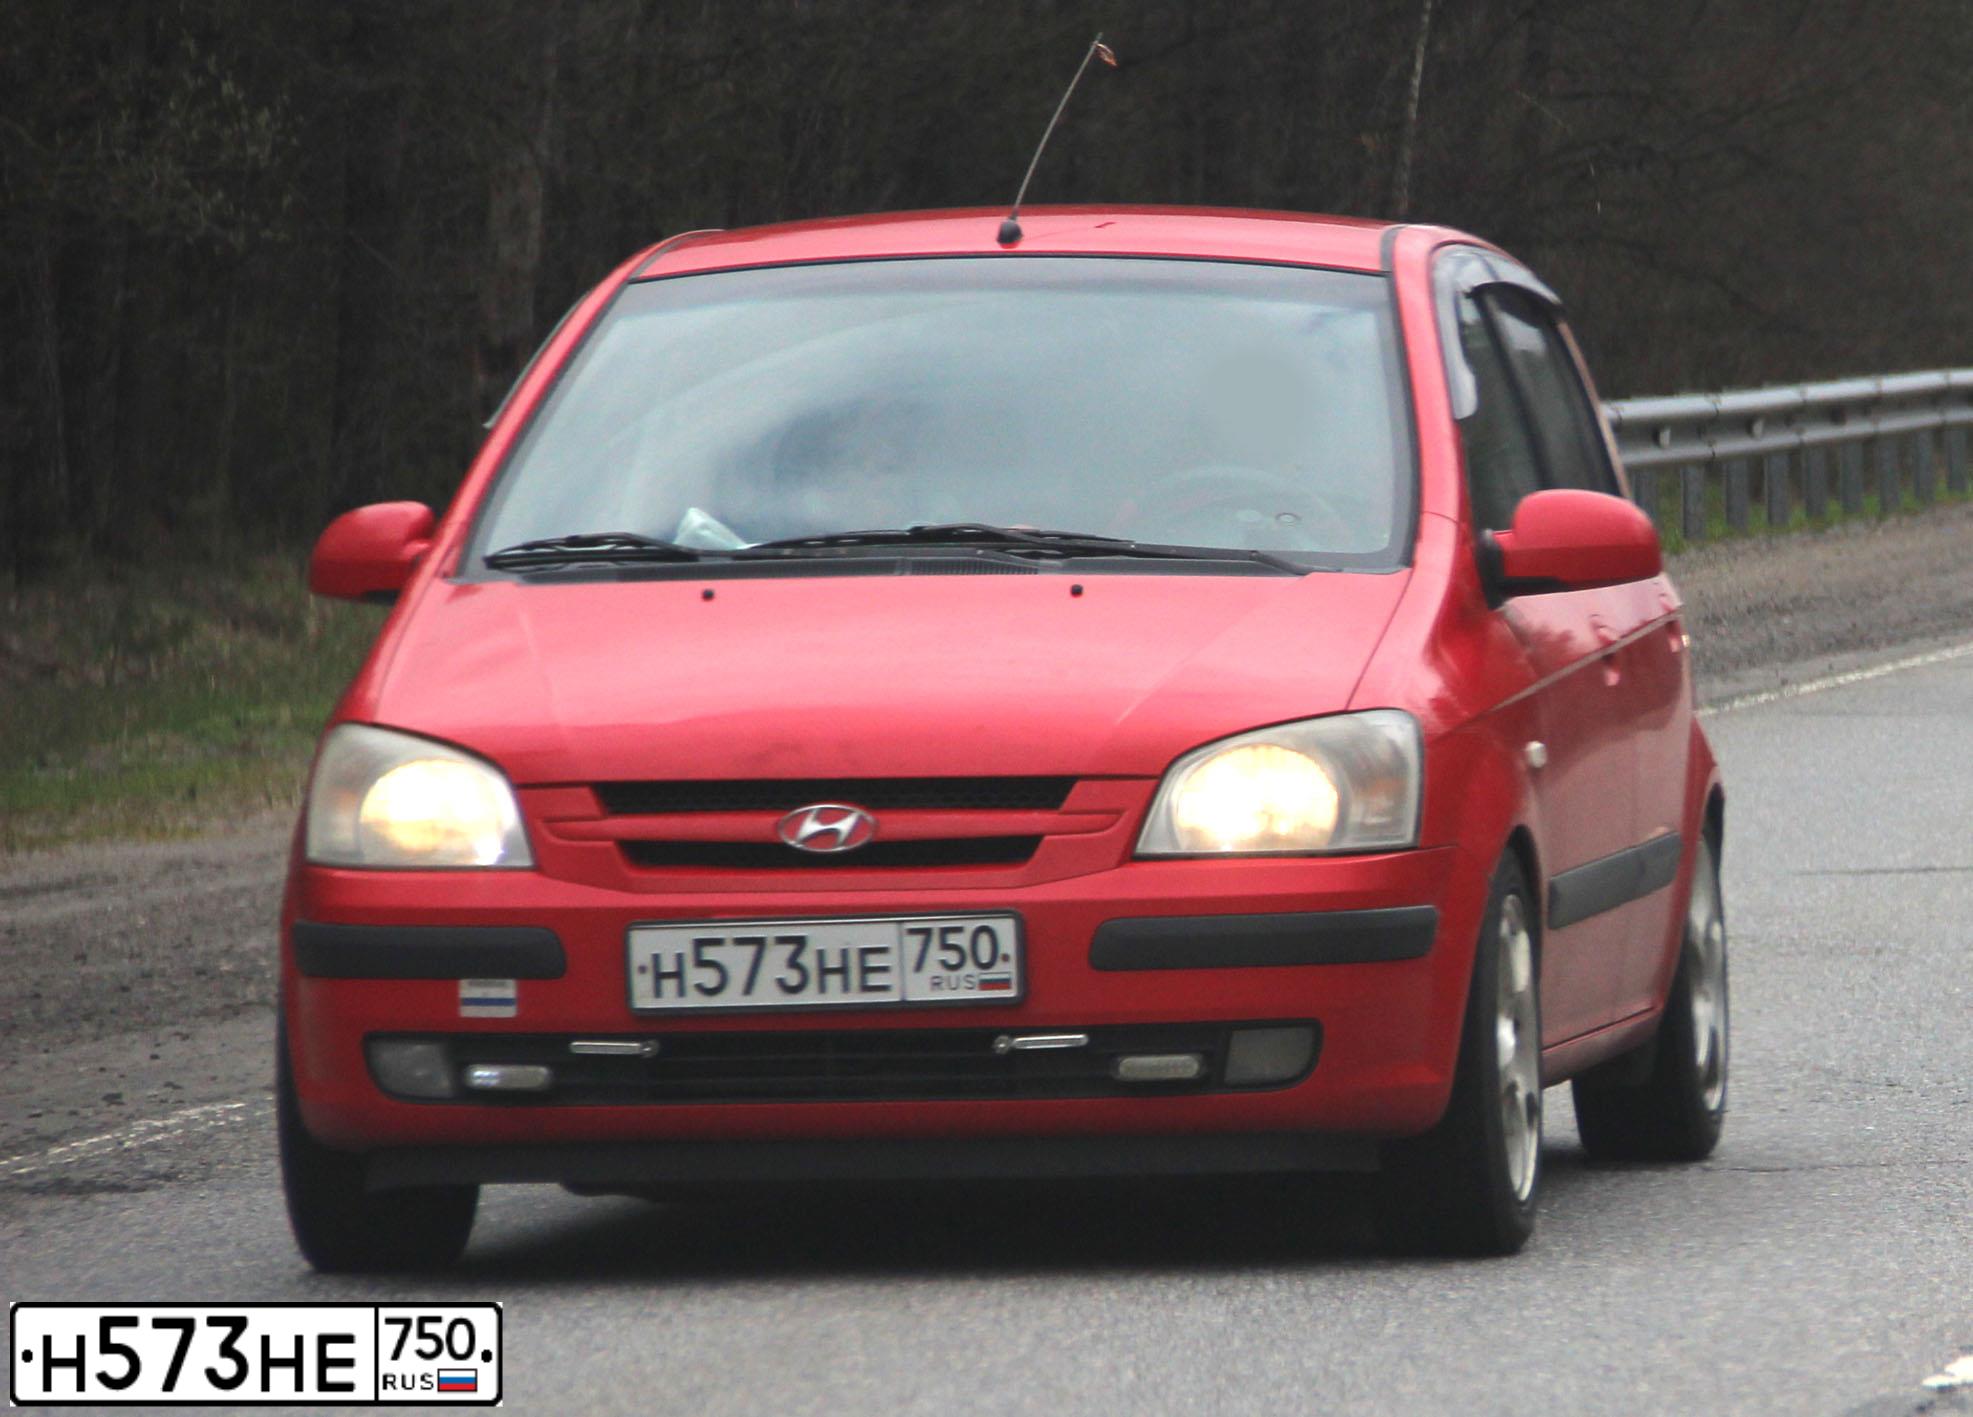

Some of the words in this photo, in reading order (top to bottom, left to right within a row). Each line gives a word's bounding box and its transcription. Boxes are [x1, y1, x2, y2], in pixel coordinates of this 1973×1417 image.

[651, 934, 893, 998] H573HE
[906, 924, 999, 973] 750
[931, 975, 977, 991] RUS
